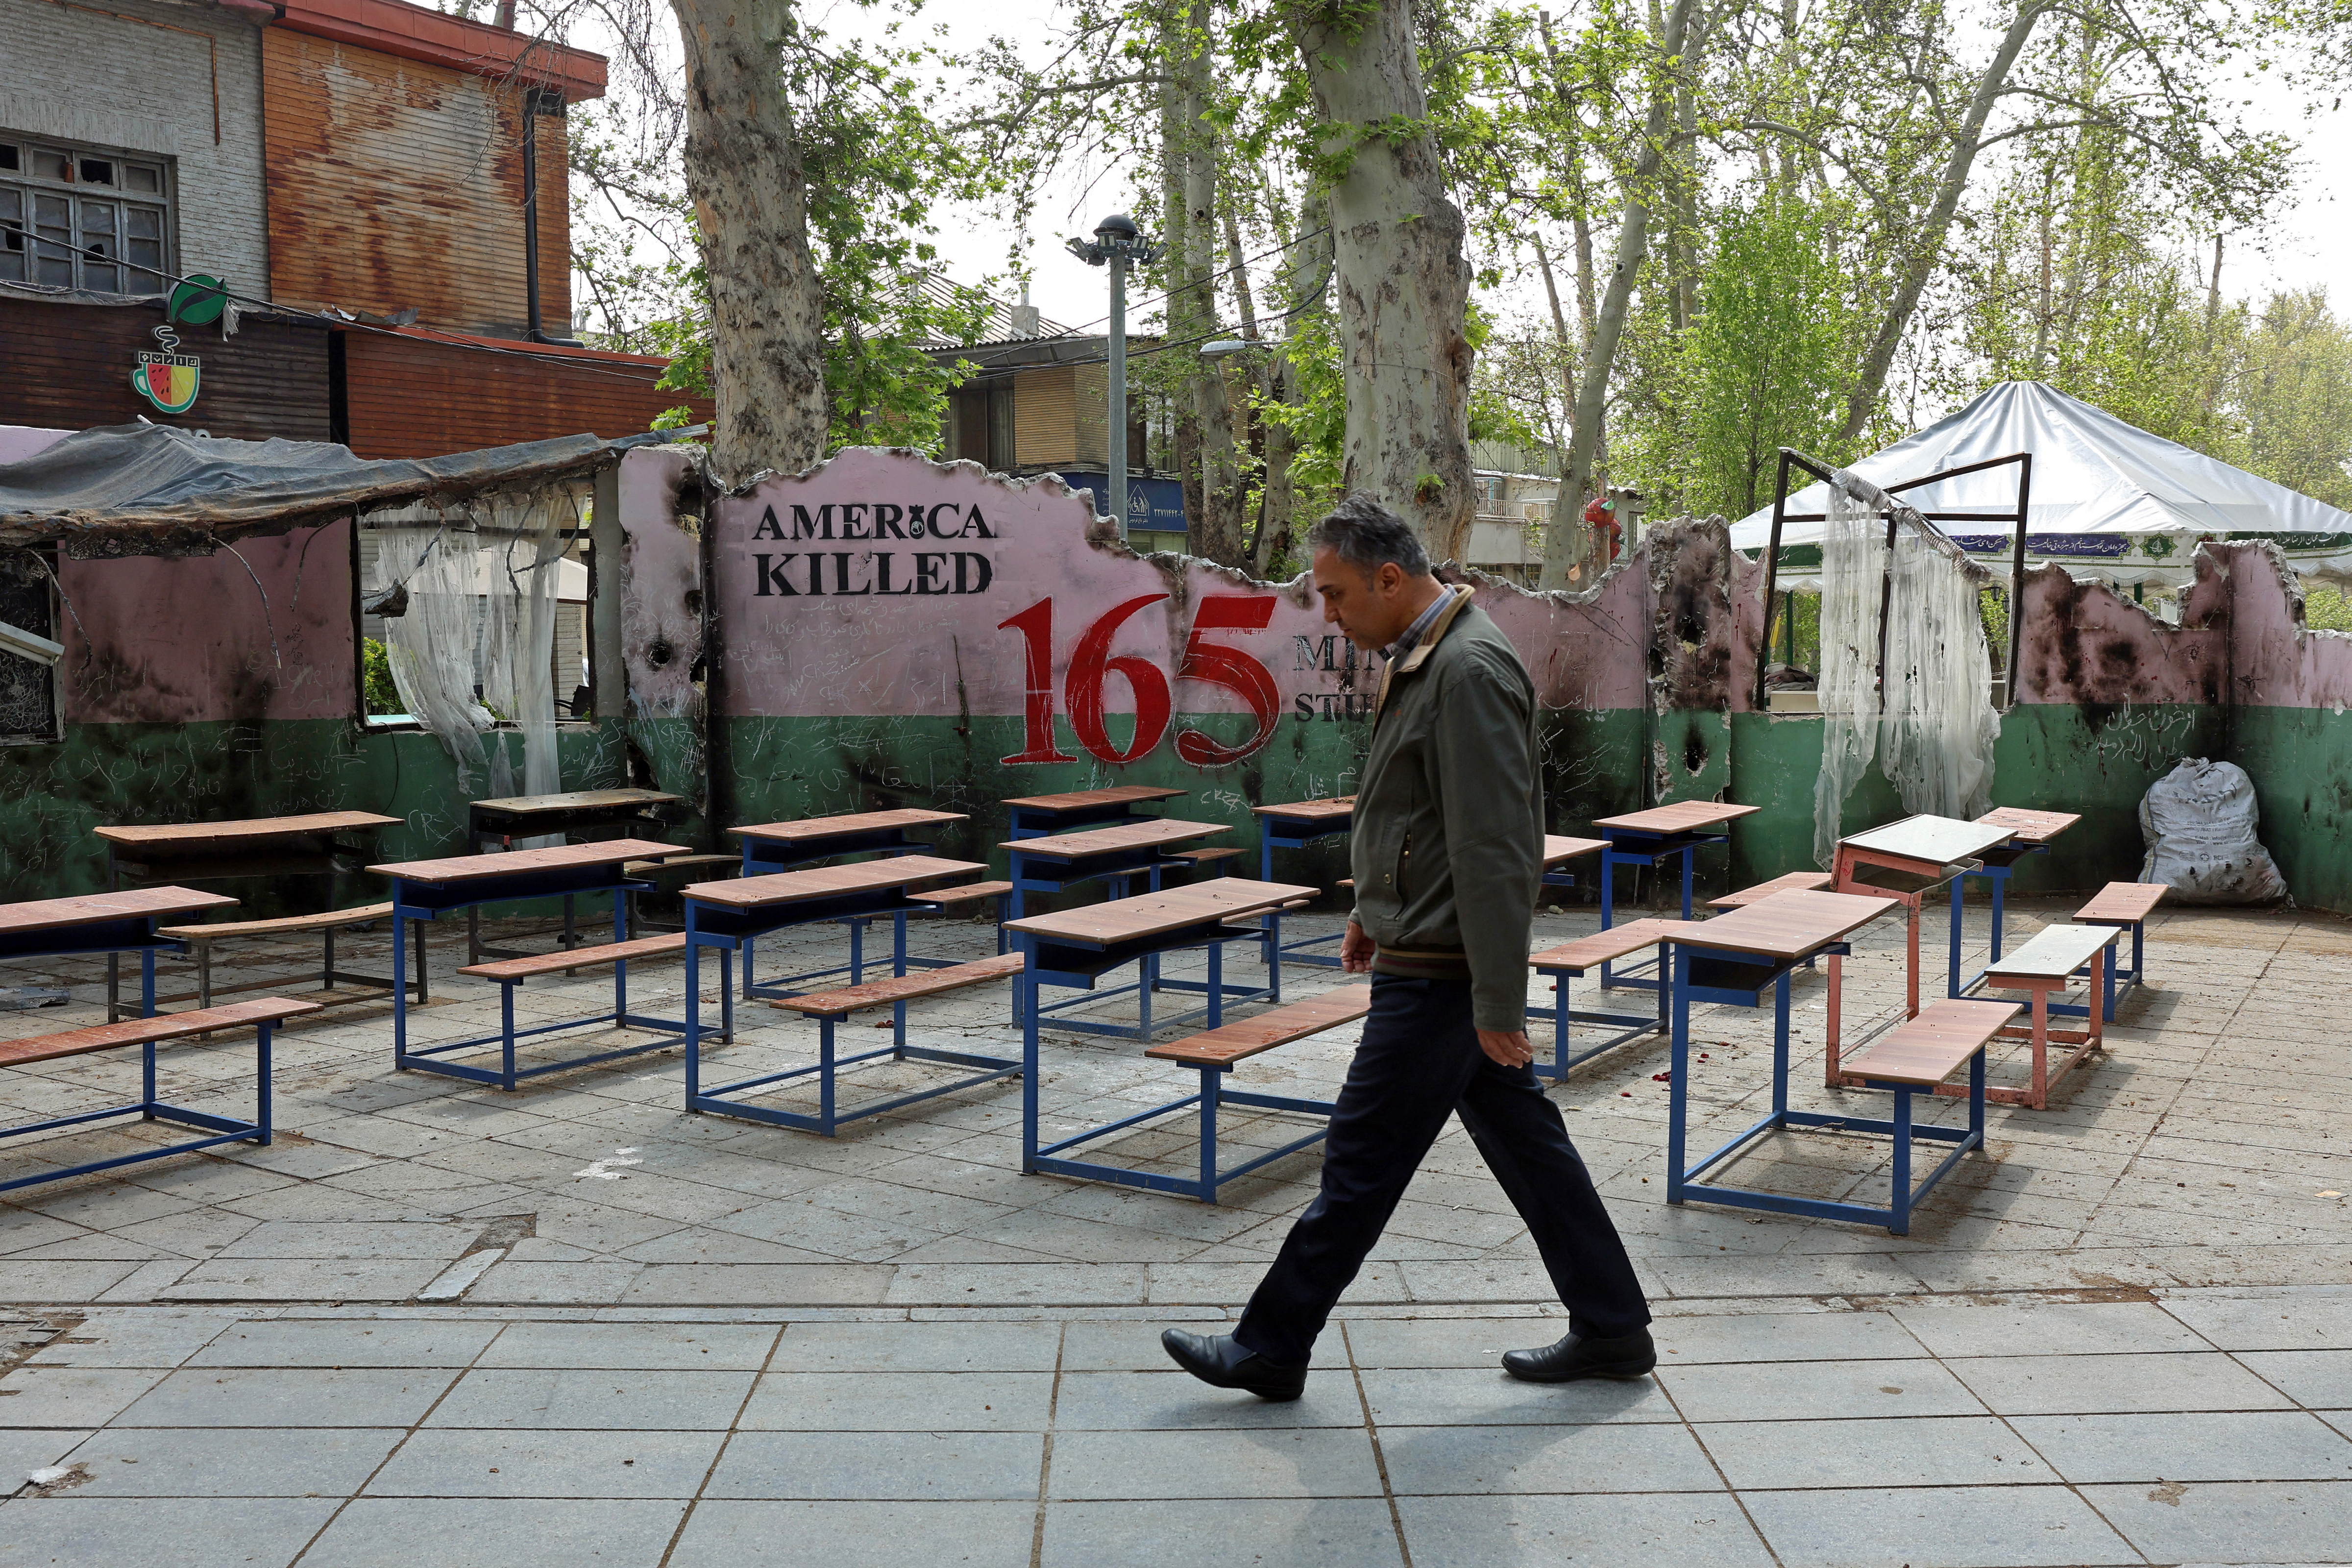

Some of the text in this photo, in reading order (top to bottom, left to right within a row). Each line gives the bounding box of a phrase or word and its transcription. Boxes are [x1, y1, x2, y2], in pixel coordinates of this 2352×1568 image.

[1988, 537, 2005, 548] مکن
[2282, 536, 2290, 548] علیه
[2292, 535, 2305, 546] الرضا
[2305, 534, 2318, 548] محبان
[2319, 532, 2337, 546] موکب
[752, 552, 993, 596] KILLED
[997, 593, 1281, 768] 165
